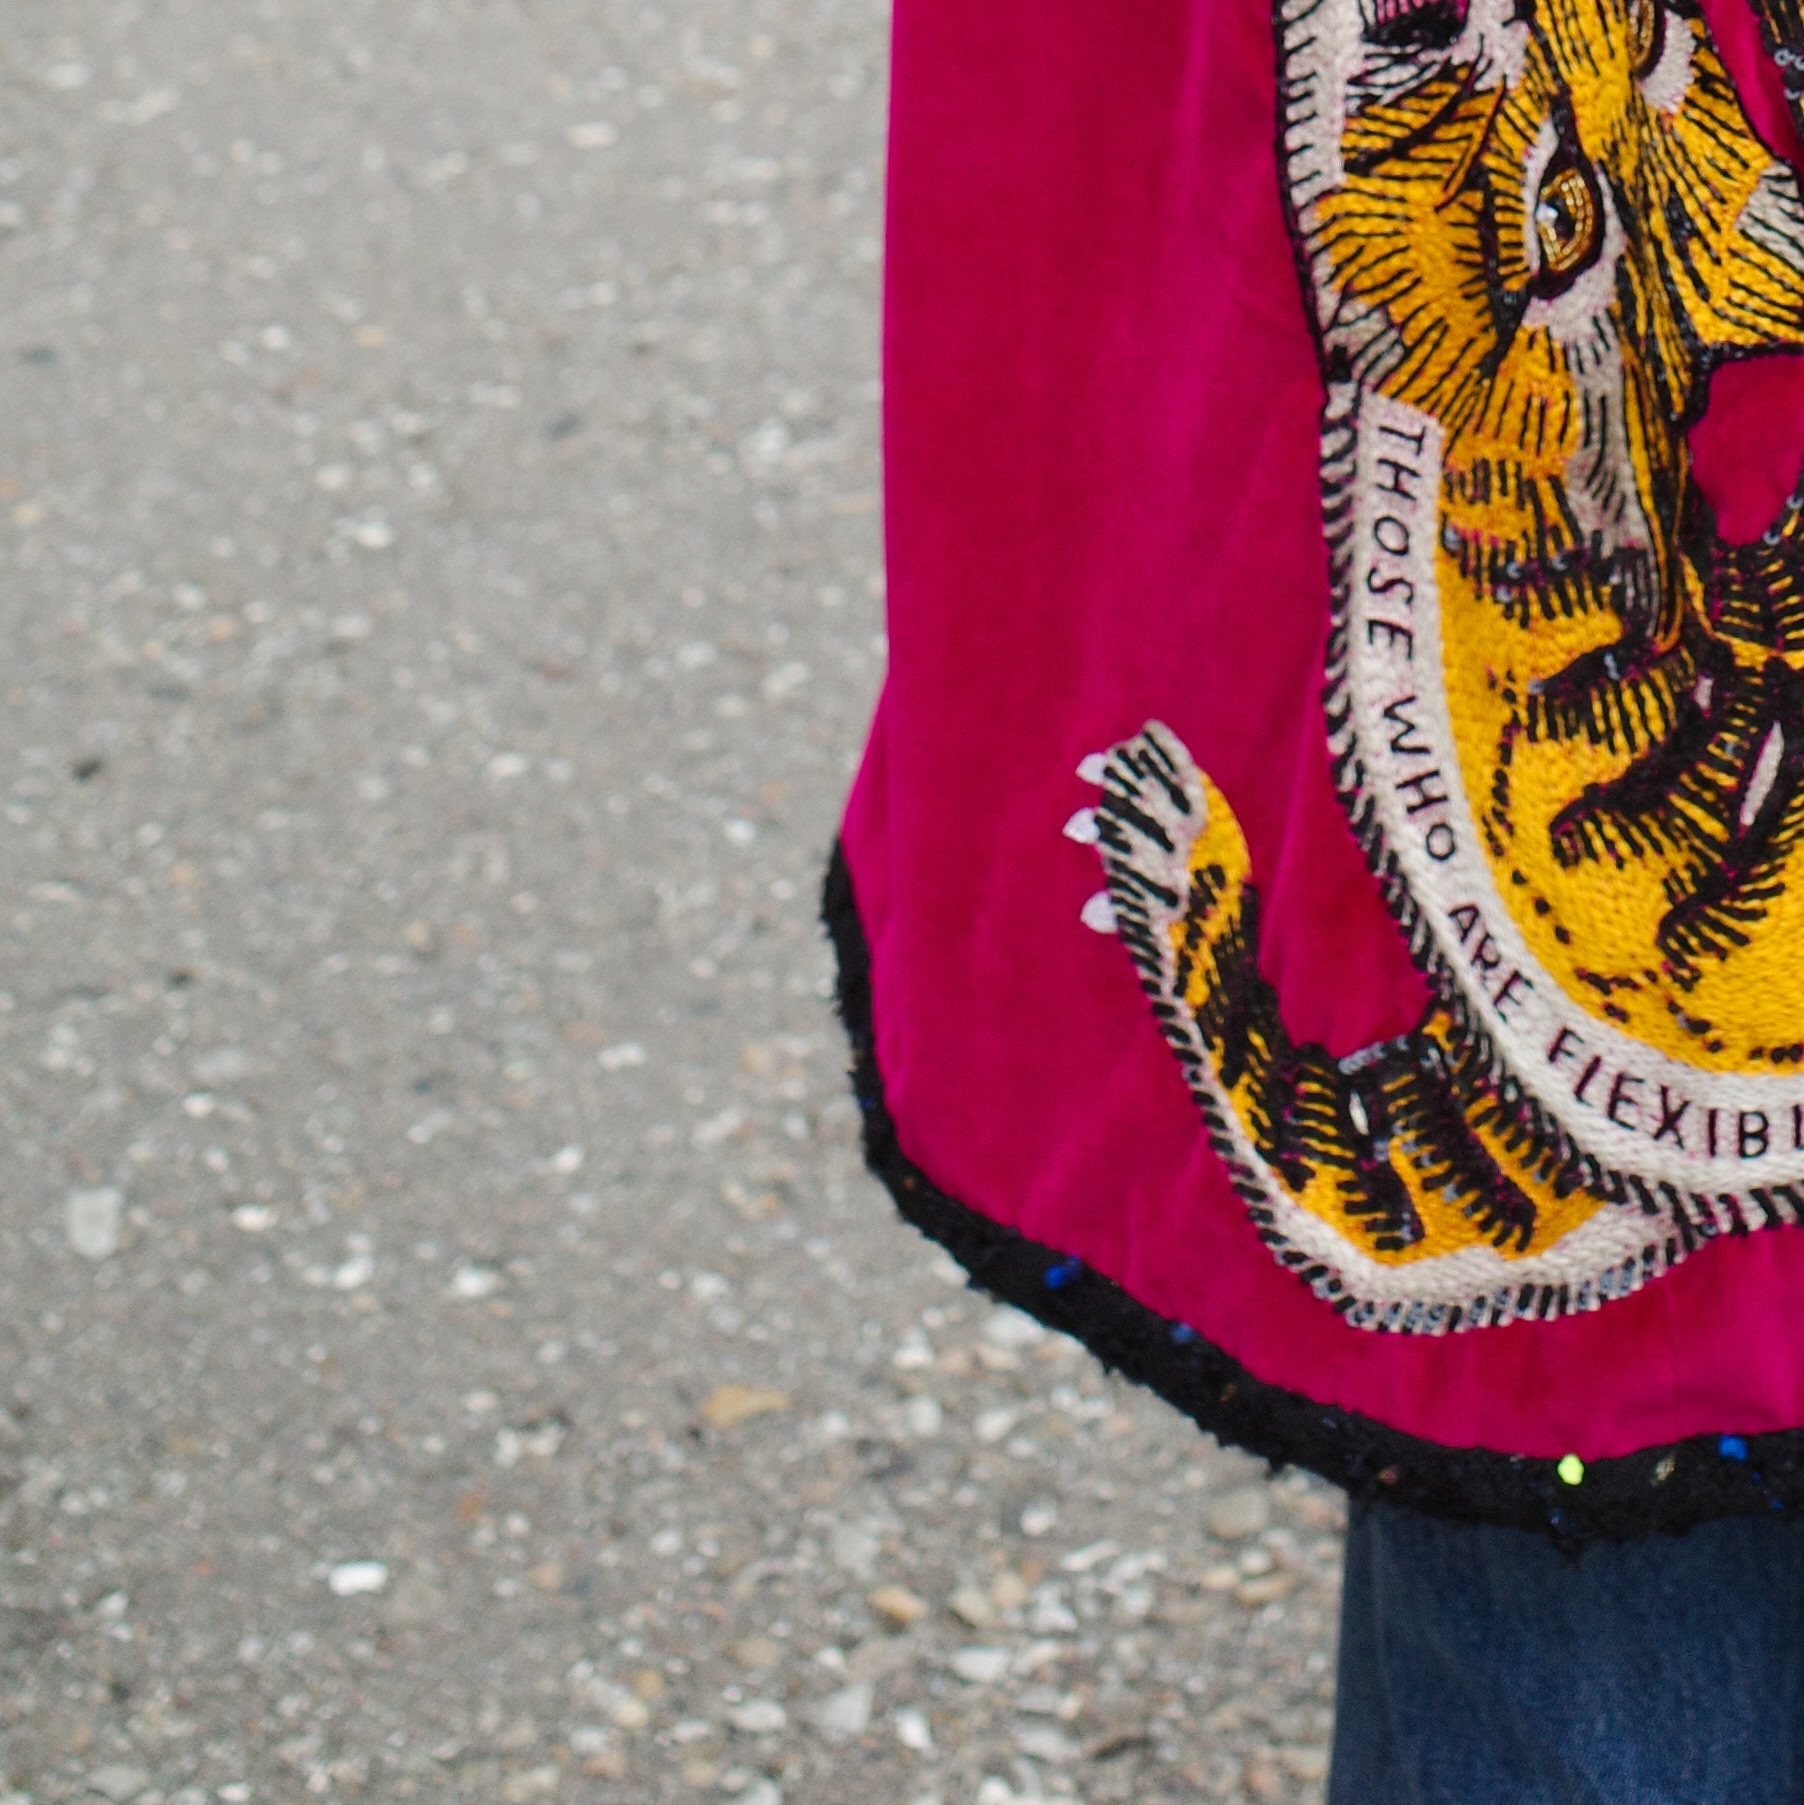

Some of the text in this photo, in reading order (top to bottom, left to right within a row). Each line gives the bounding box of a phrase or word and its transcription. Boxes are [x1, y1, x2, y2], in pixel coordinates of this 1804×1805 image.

[1366, 422, 1428, 662] THOSE
[1382, 695, 1458, 864] WHO
[1447, 902, 1536, 1024] ARE
